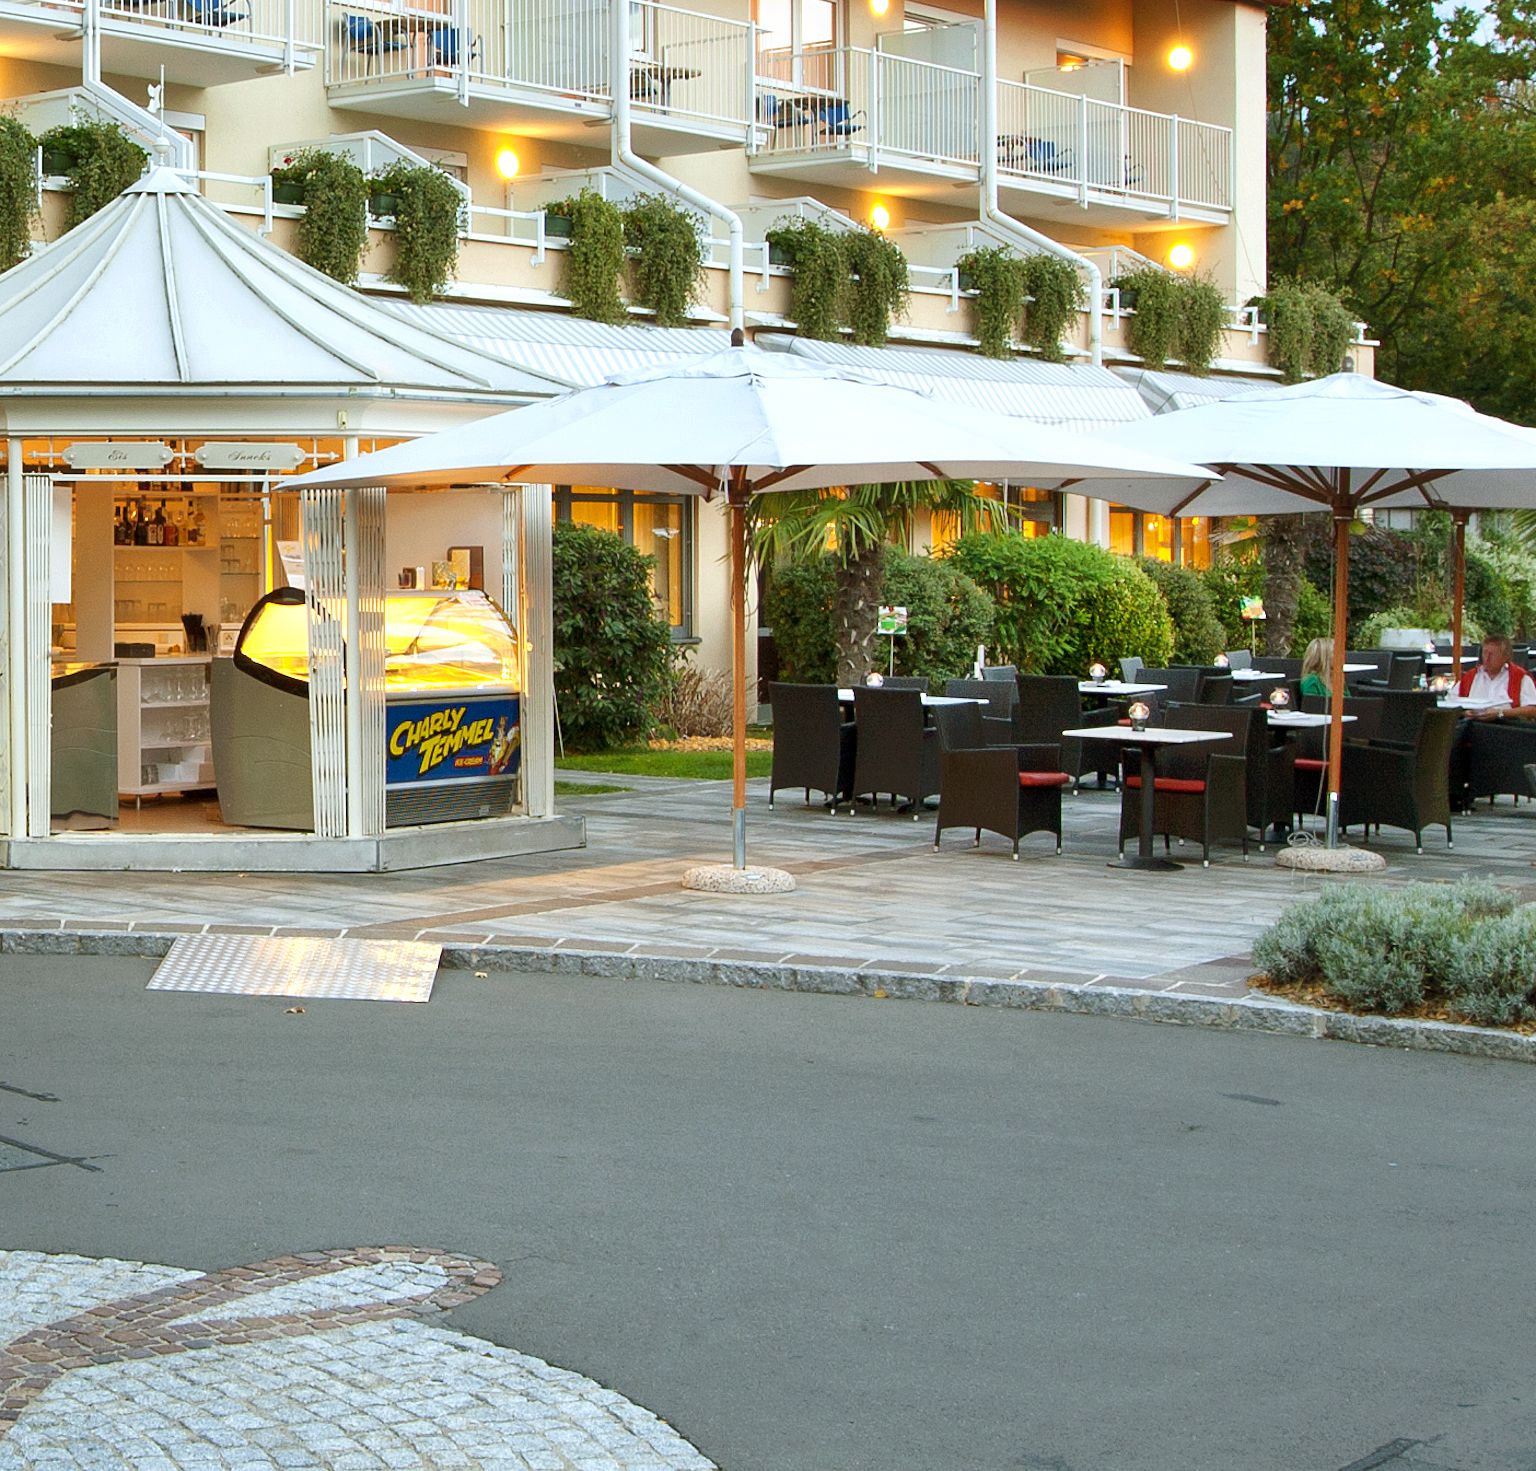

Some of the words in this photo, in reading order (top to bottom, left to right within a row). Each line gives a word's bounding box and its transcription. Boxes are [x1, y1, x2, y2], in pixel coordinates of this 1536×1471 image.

[107, 449, 128, 461] Eis
[228, 450, 272, 462] Snacks
[389, 706, 467, 757] CHARLY
[418, 718, 495, 775] TEMMEL
